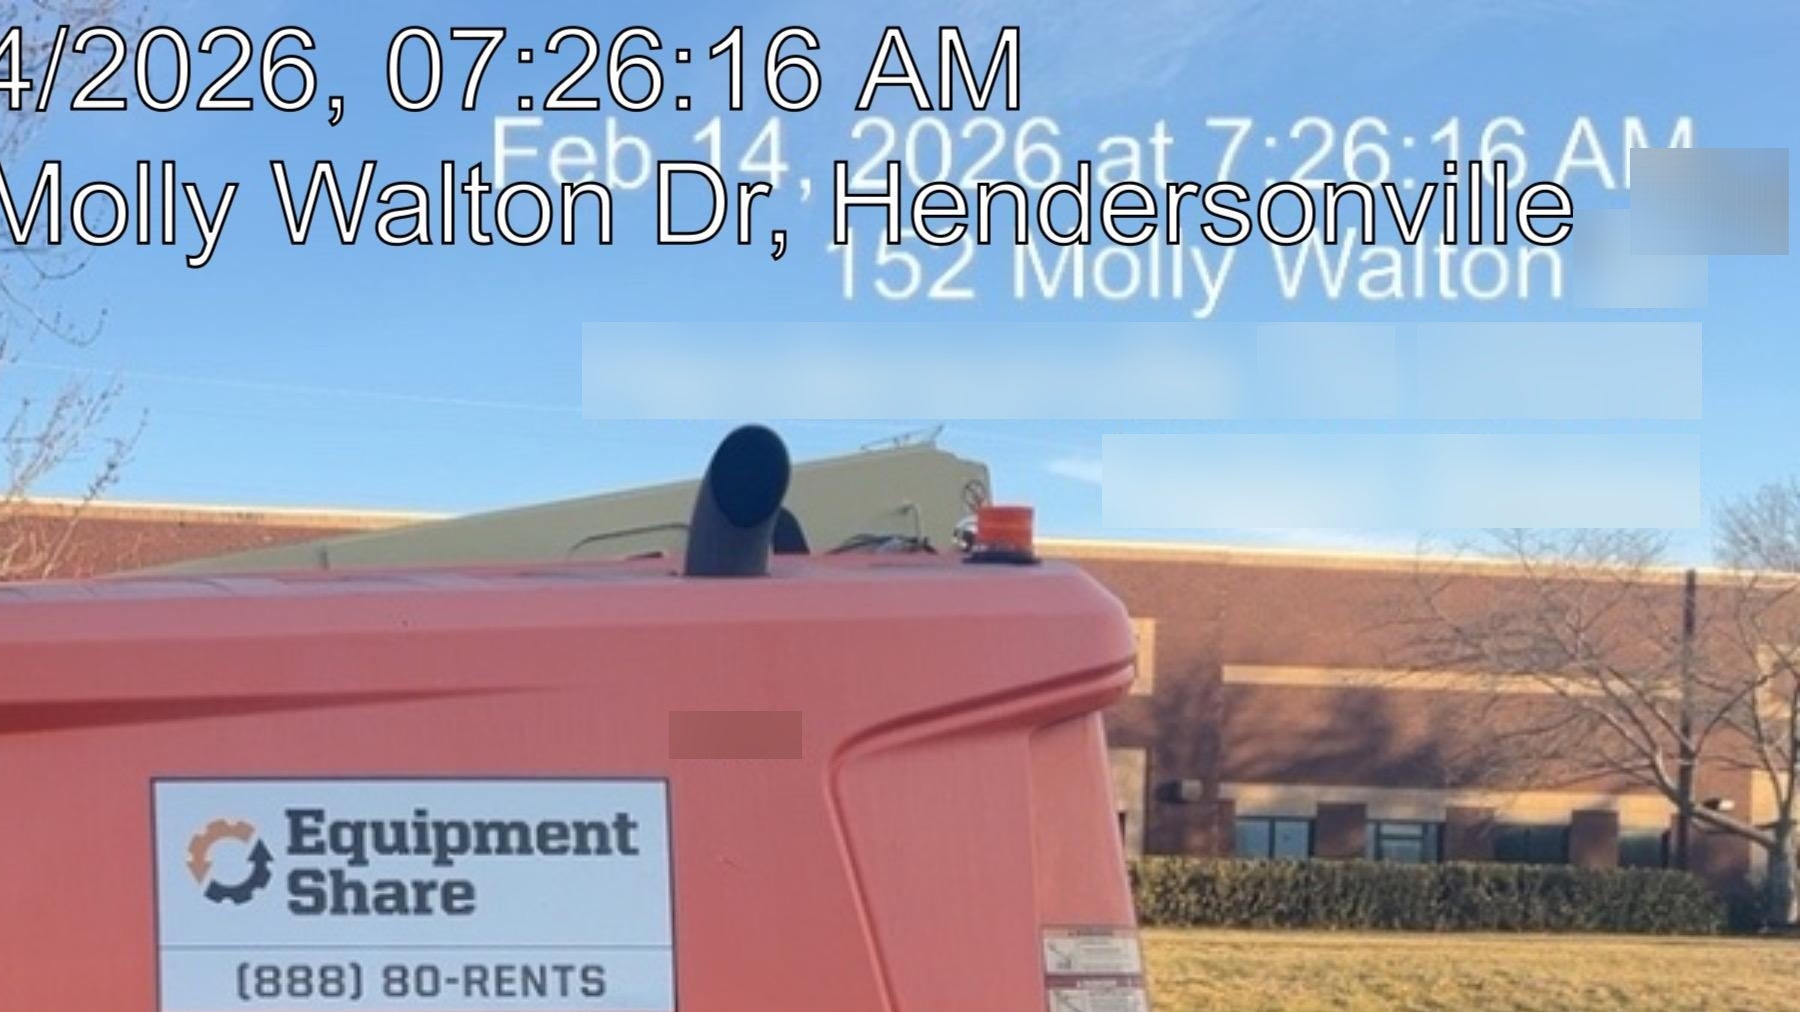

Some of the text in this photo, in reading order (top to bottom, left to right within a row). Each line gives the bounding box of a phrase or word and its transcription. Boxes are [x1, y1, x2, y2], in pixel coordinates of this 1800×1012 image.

[285, 808, 639, 867] Equipment
[286, 869, 476, 916] Share
[236, 962, 607, 1000] (888) 80-RENTS
